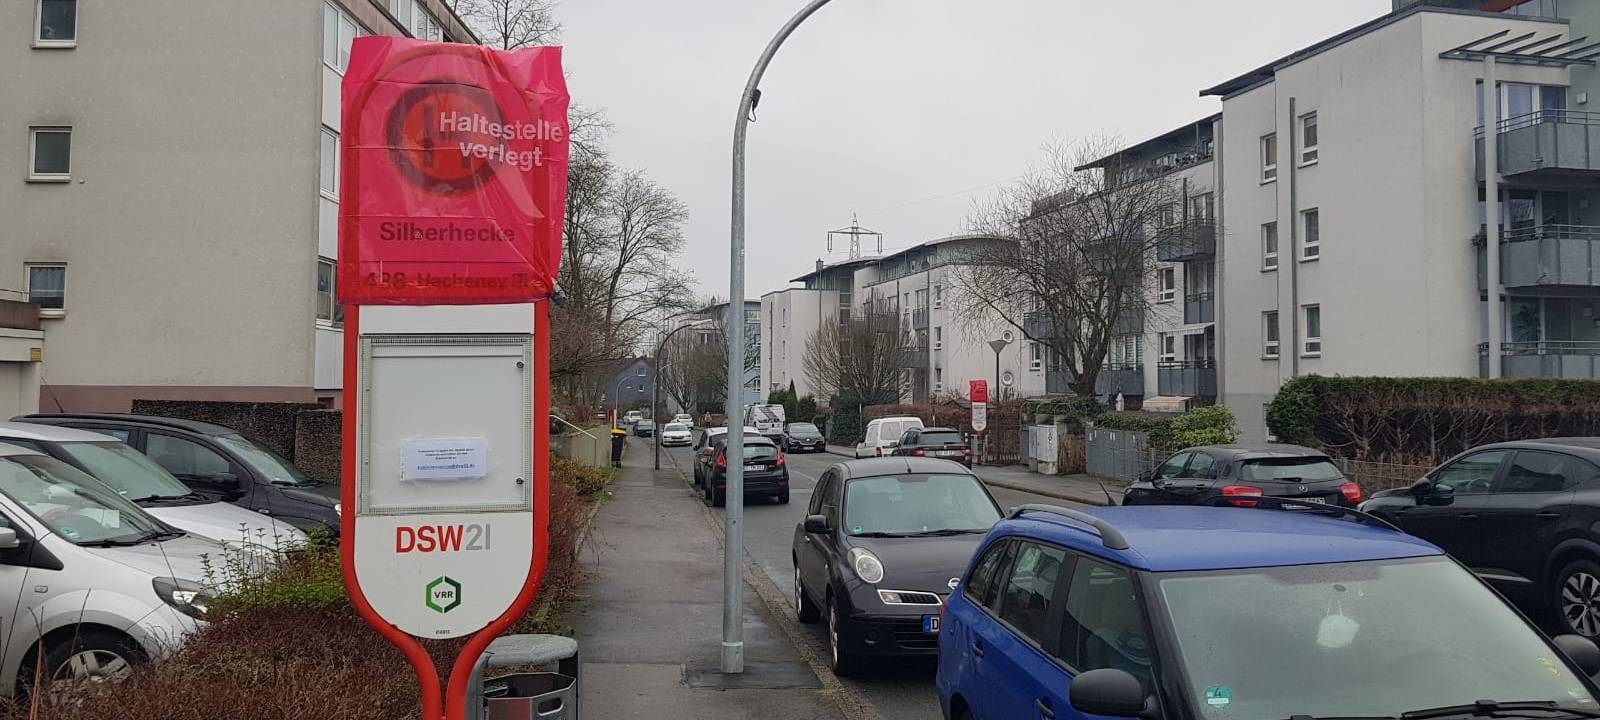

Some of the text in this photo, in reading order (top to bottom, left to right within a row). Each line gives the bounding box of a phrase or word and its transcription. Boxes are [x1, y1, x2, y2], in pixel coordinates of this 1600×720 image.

[439, 111, 564, 143] Haltestelle
[459, 141, 543, 171] verlegt
[379, 222, 515, 242] Silberhecke
[395, 523, 492, 553] DSW21
[434, 590, 454, 599] VRR
